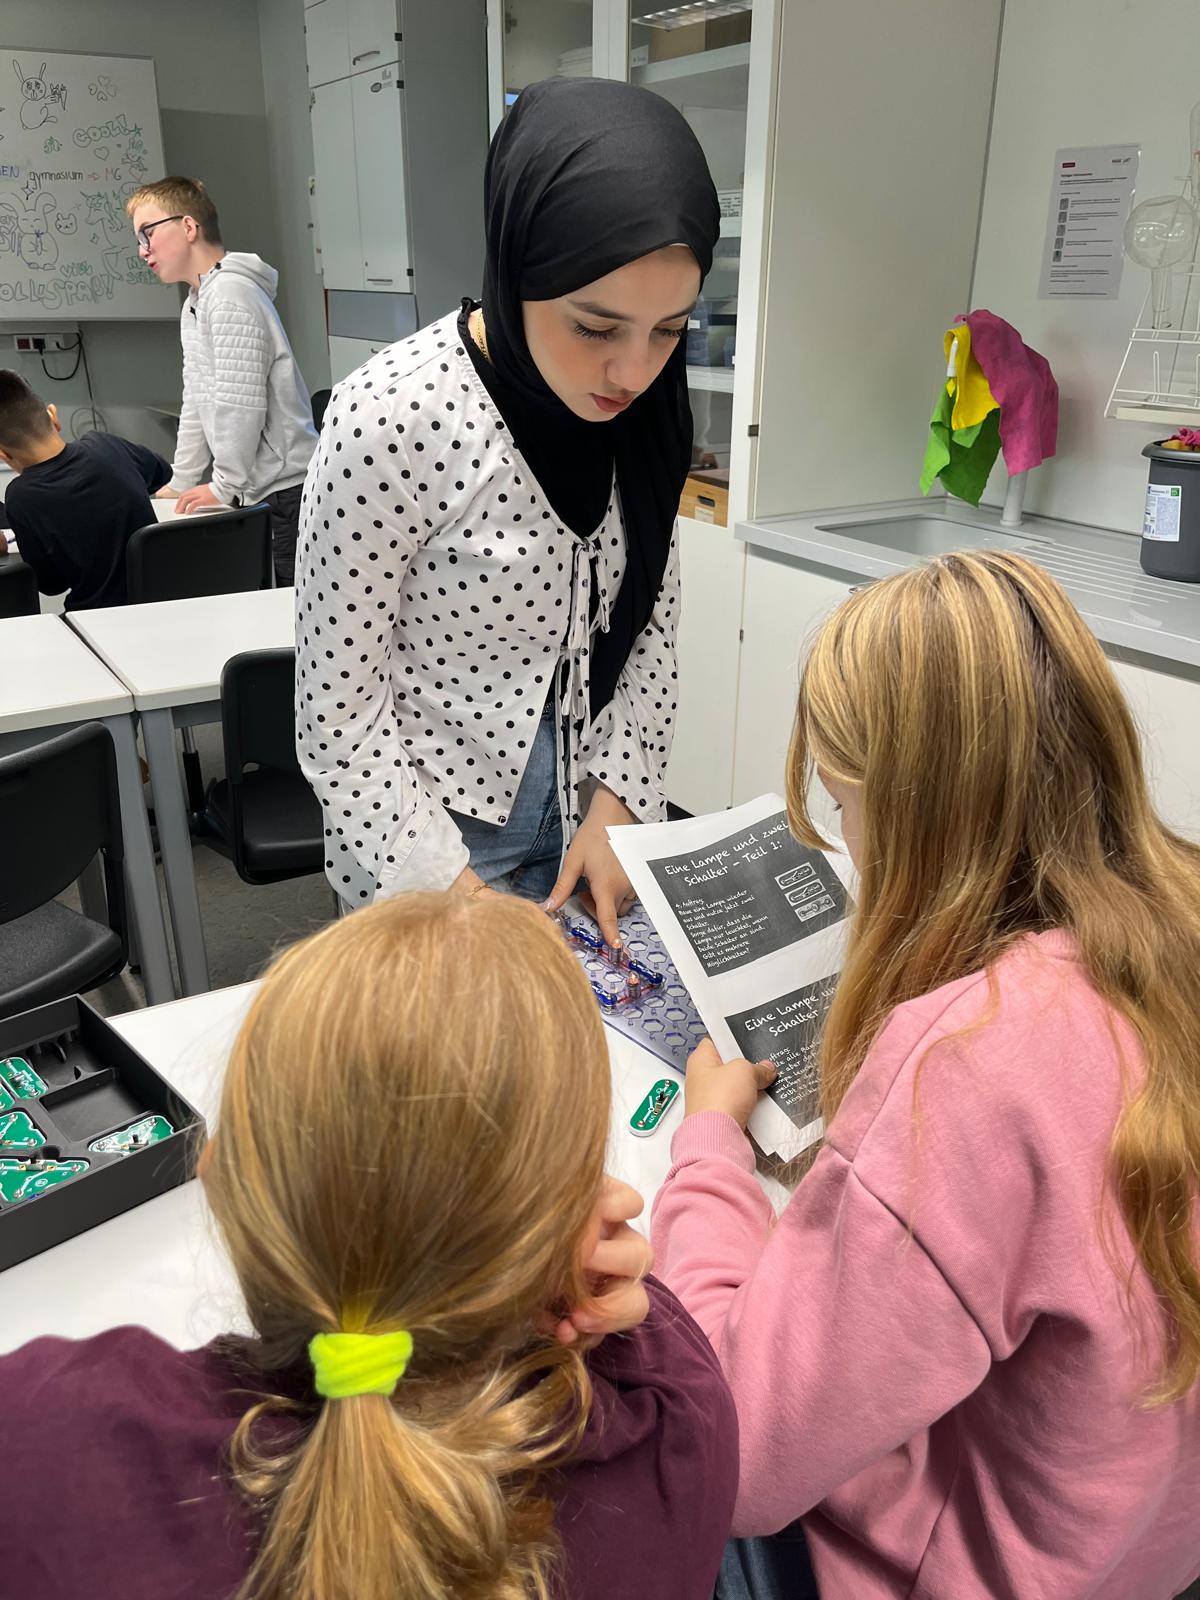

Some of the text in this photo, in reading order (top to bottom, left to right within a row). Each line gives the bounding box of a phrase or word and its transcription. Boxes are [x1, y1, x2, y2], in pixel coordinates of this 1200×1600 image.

[0, 166, 20, 178] EN
[29, 171, 84, 190] gymnasium
[664, 820, 788, 875] Eine Lampe und zwei
[684, 865, 728, 886] Schalter
[742, 846, 768, 863] Teil
[770, 840, 783, 850] 1:
[693, 913, 705, 921] und
[724, 901, 739, 913] jetzt
[741, 895, 755, 905] zwei
[706, 900, 725, 909] Lampe
[726, 890, 747, 902] wieder
[694, 937, 712, 946] Lampe
[752, 915, 769, 925] wenn
[726, 918, 740, 927] dass
[702, 952, 716, 960] Gibt
[725, 941, 750, 952] mehrere
[714, 936, 738, 948] Schalter
[744, 1013, 777, 1031] Eine
[776, 995, 820, 1016] Lampe
[769, 1009, 819, 1037] Schalter
[786, 1052, 800, 1061] alle
[786, 1061, 801, 1071] aber
[780, 1087, 797, 1099] Gibt
